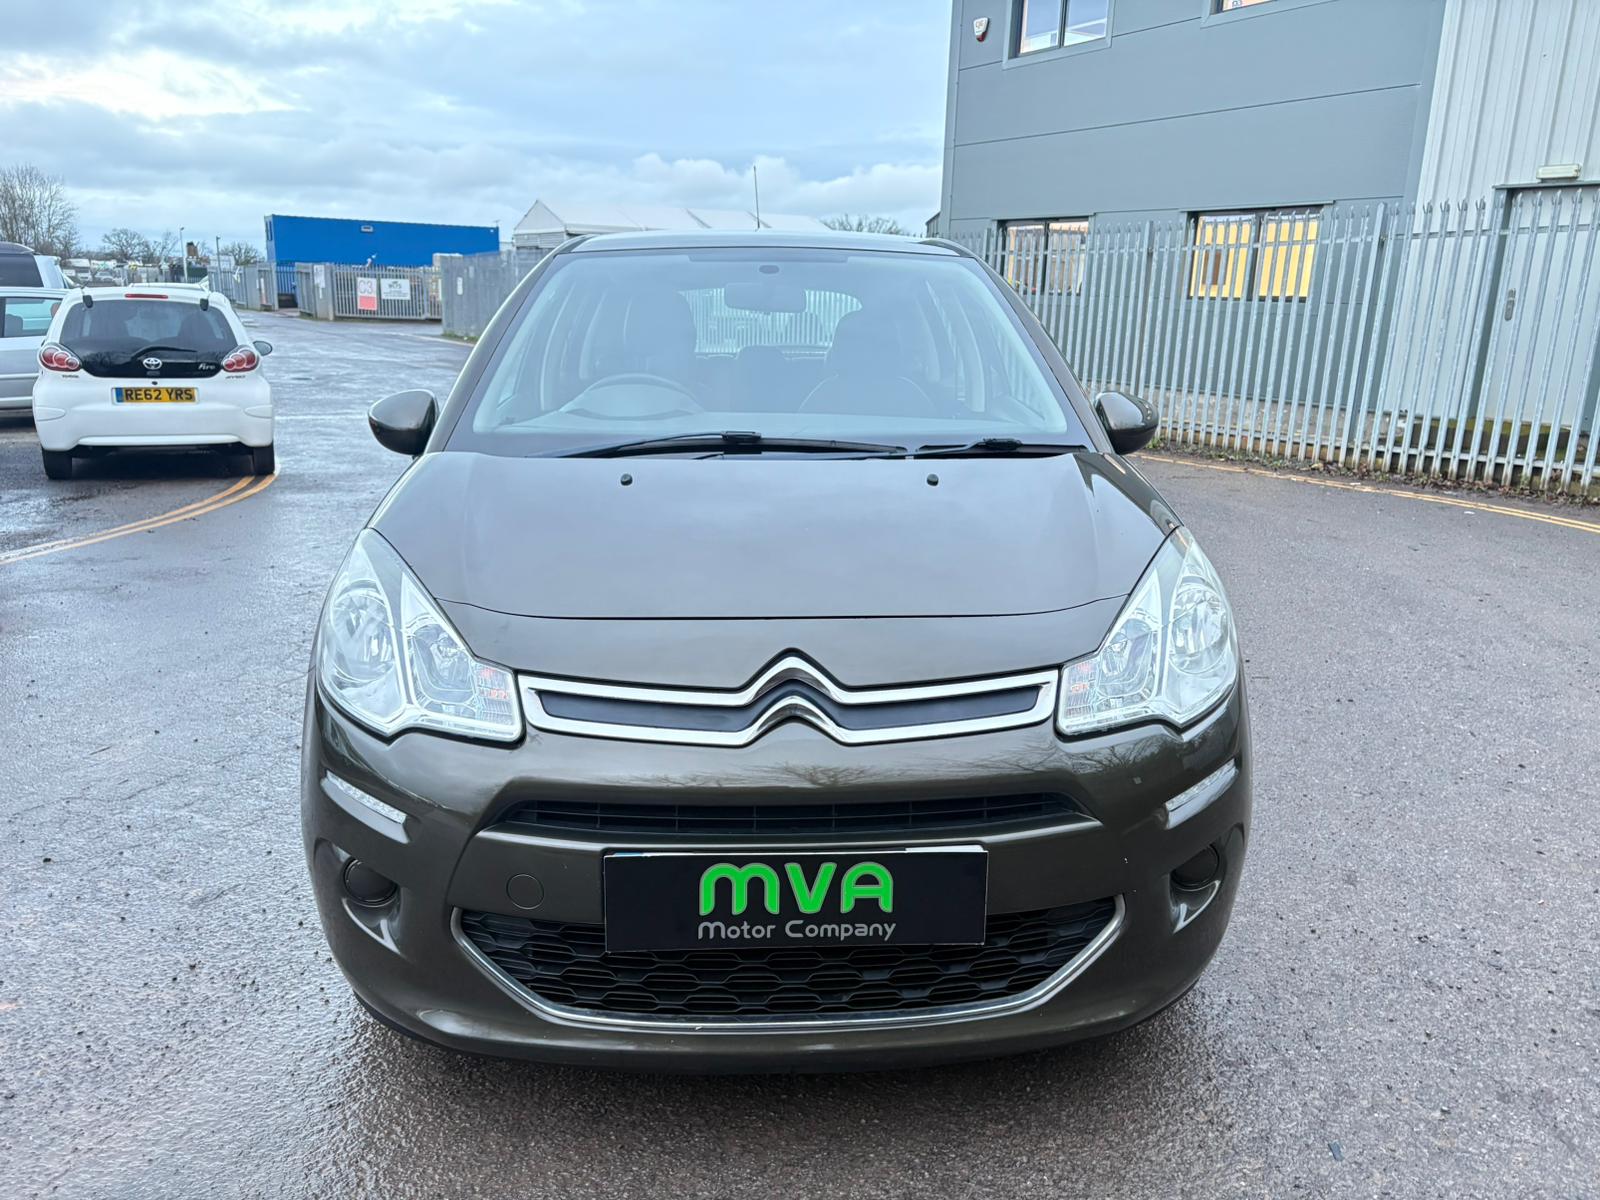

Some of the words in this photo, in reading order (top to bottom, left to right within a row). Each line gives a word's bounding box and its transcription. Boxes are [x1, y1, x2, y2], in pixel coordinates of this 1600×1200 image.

[124, 389, 162, 401] RE62
[165, 388, 193, 401] YRS
[699, 862, 894, 916] MVA
[698, 921, 776, 939] Motor
[785, 919, 897, 941] Company
